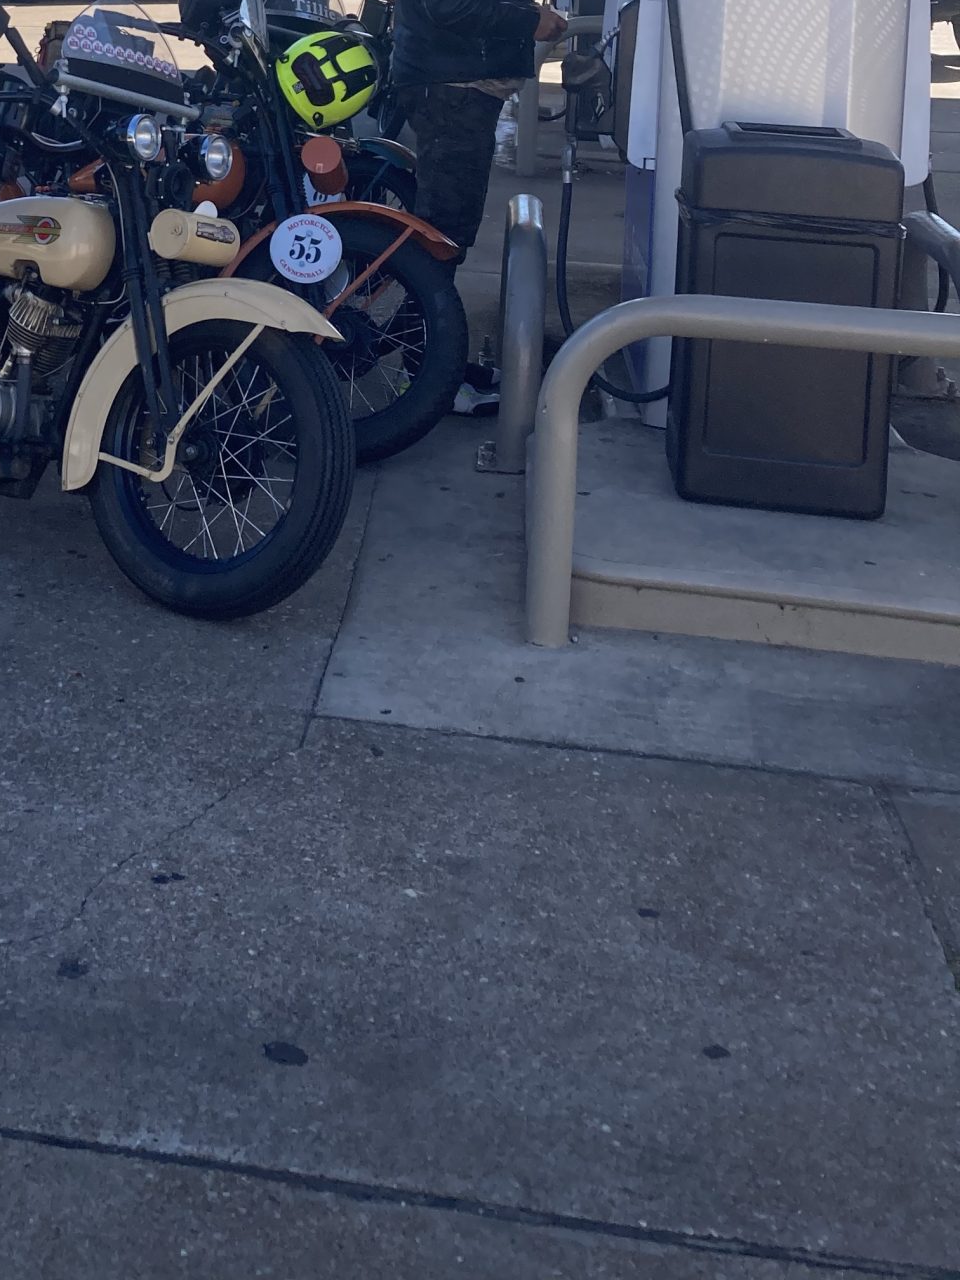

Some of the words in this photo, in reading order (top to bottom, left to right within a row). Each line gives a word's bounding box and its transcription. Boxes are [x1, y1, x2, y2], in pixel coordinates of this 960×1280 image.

[287, 219, 334, 240] MOTORCYCLE
[289, 234, 322, 263] 55
[280, 259, 324, 278] CANNONBALL
